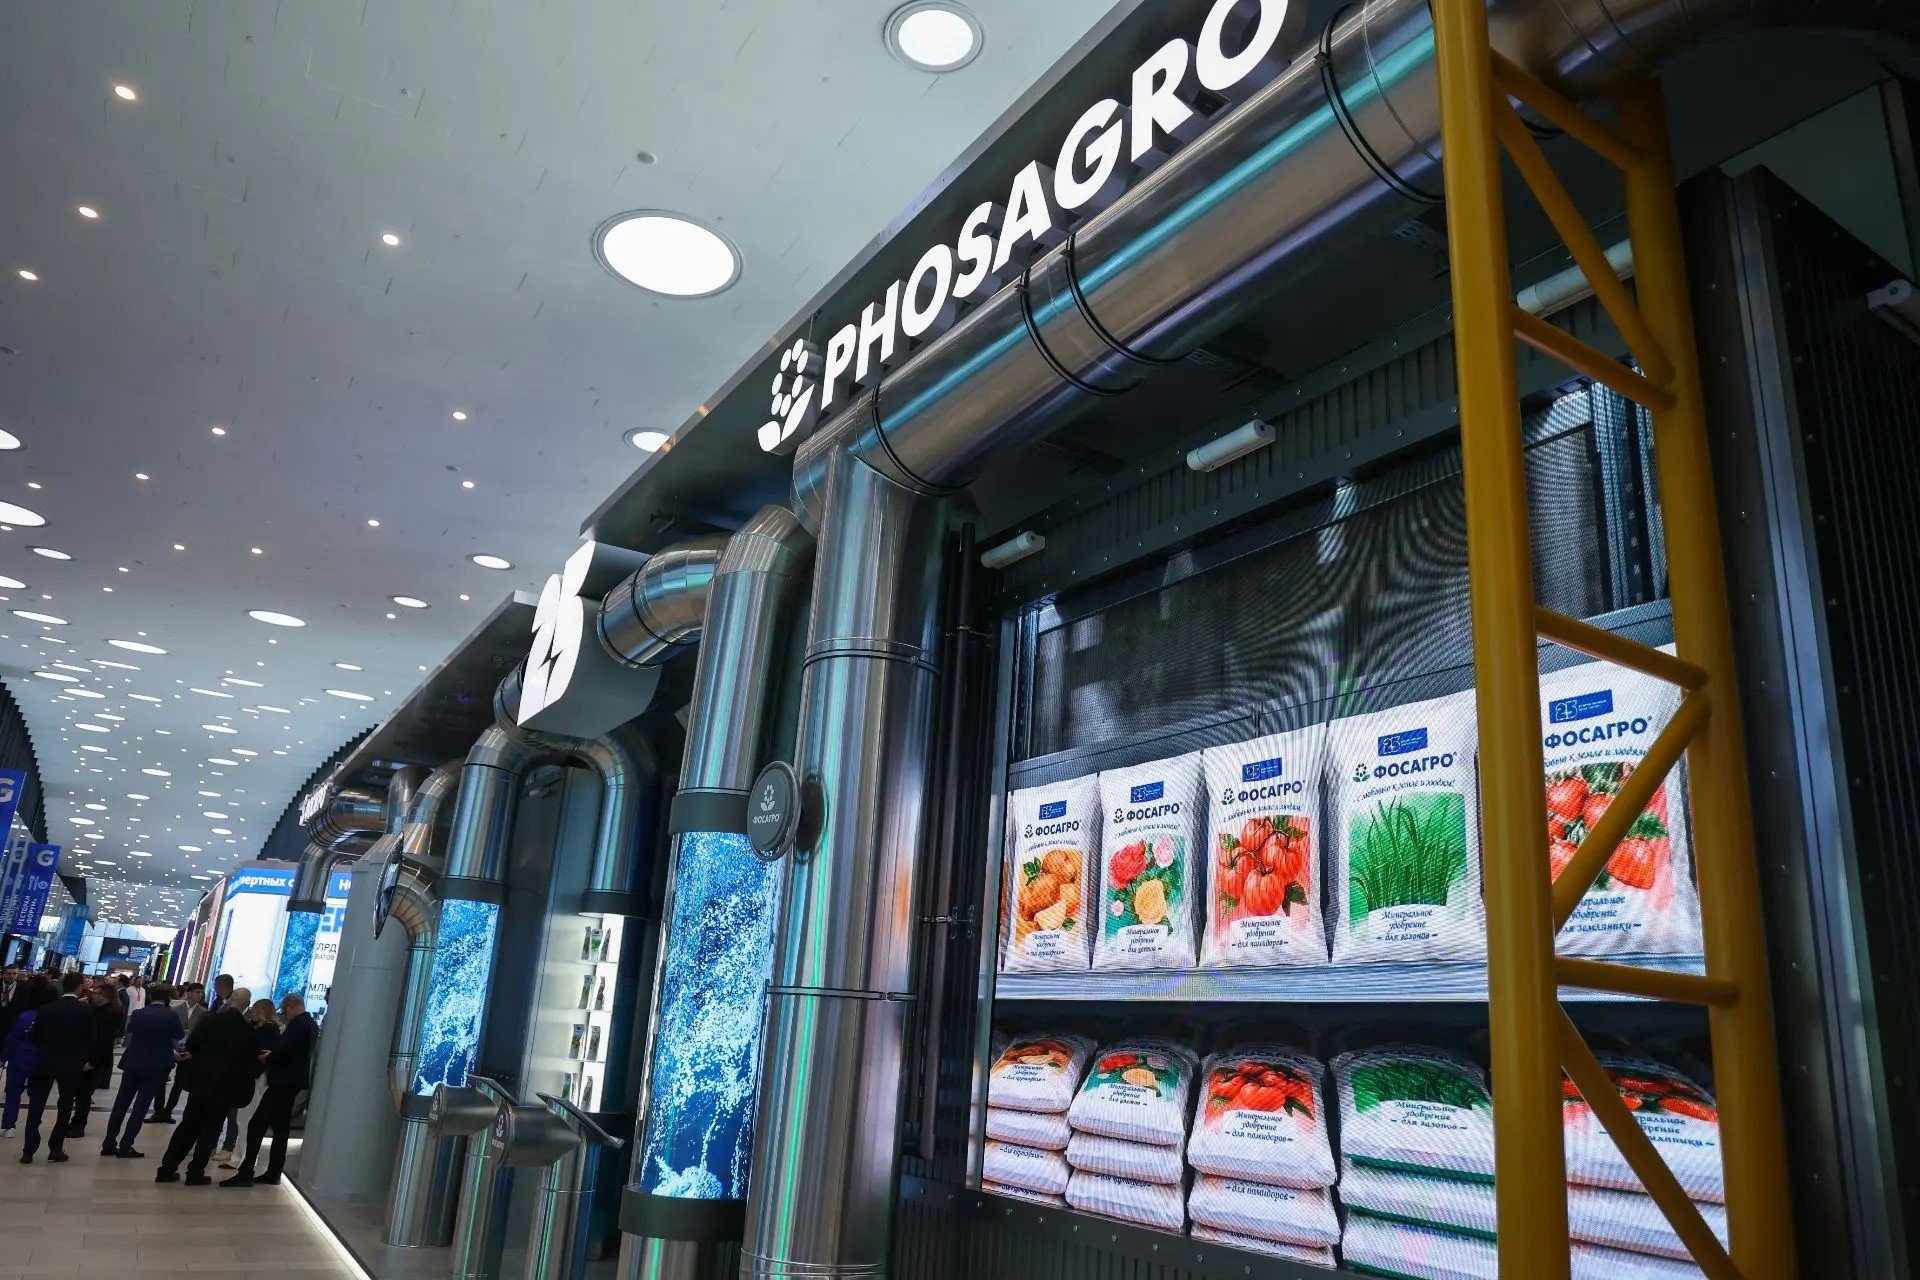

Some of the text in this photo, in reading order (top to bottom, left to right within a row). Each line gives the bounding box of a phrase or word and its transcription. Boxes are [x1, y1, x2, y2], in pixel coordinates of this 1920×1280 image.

[821, 0, 1289, 410] PHOSAGRO
[1544, 717, 1648, 749] ФОСАГРО
[1373, 753, 1454, 779] ФОСАГРО
[1238, 780, 1303, 803] ФОСАГРО
[753, 813, 780, 824] ФОСАГРО
[1126, 802, 1180, 822] ФОСАГРО
[1035, 820, 1080, 837] ФОСАГРО
[37, 850, 54, 867] G
[316, 942, 337, 955] ЛРД
